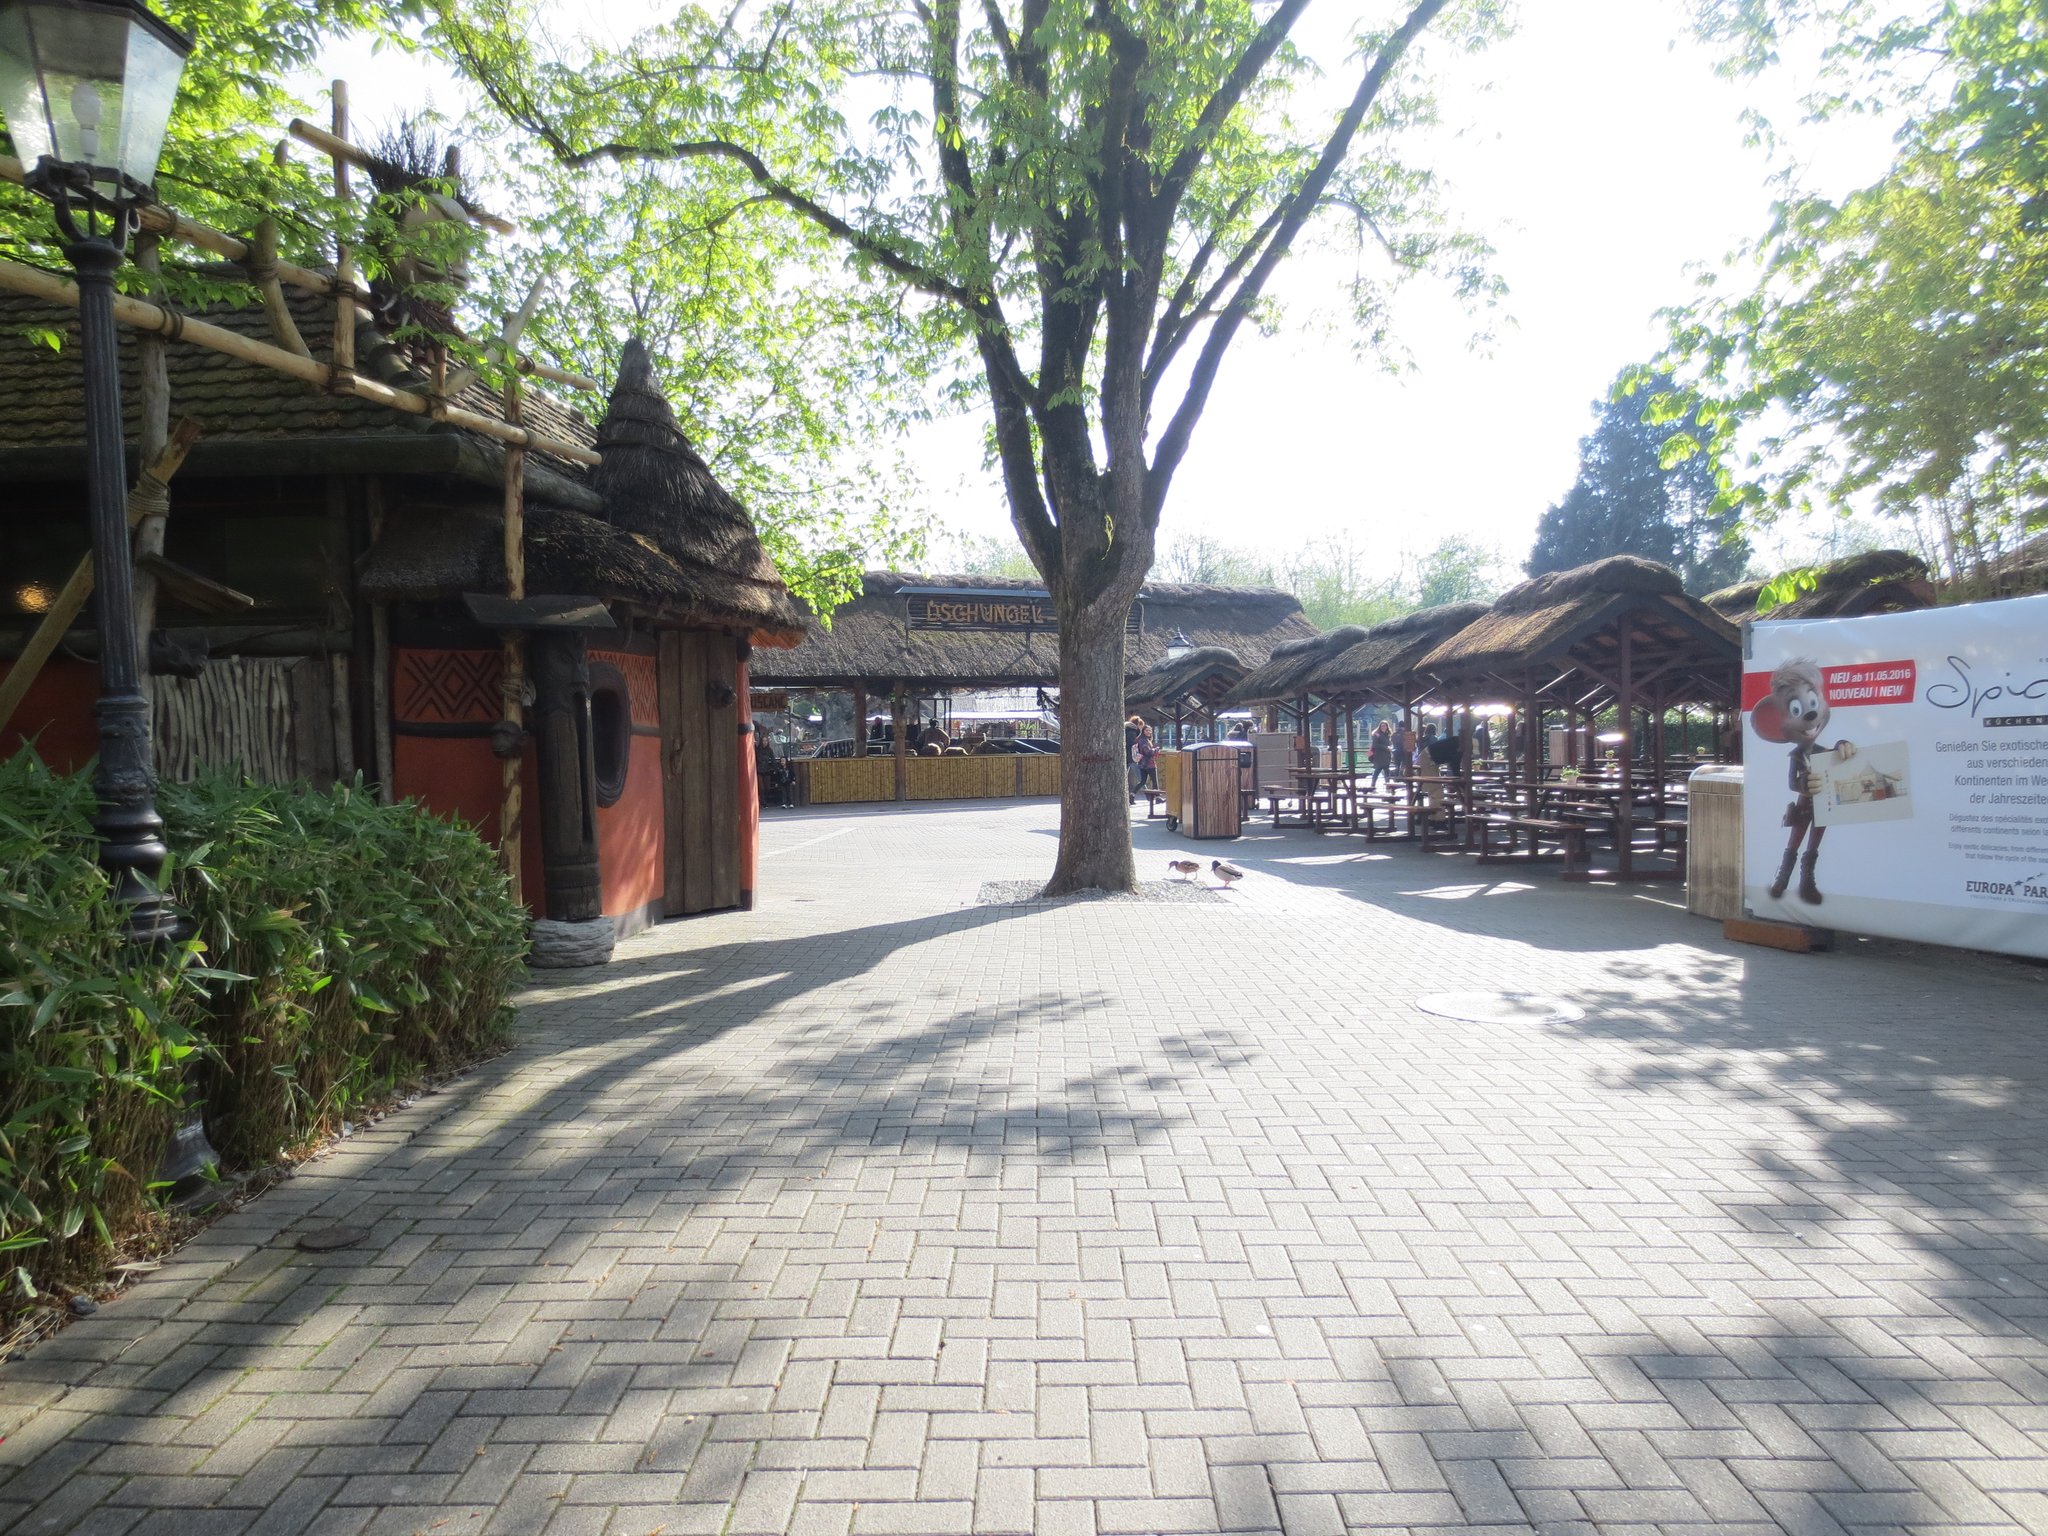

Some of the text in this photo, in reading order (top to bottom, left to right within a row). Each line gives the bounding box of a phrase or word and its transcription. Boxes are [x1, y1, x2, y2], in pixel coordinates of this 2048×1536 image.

[1829, 668, 1911, 684] NEU ab 11.05.2016
[1829, 686, 1873, 700] NOUVEAU
[1879, 685, 1904, 698] NEW
[1936, 741, 1979, 753] Genießen
[1981, 740, 1997, 752] Sie
[1967, 759, 1985, 768] aus
[1955, 775, 2012, 786] Kontinenten
[2015, 775, 2028, 786] im
[1969, 793, 2048, 805] der Jahreszeite
[1980, 814, 1994, 823] des
[1965, 880, 2048, 899] EUROPA PAR
